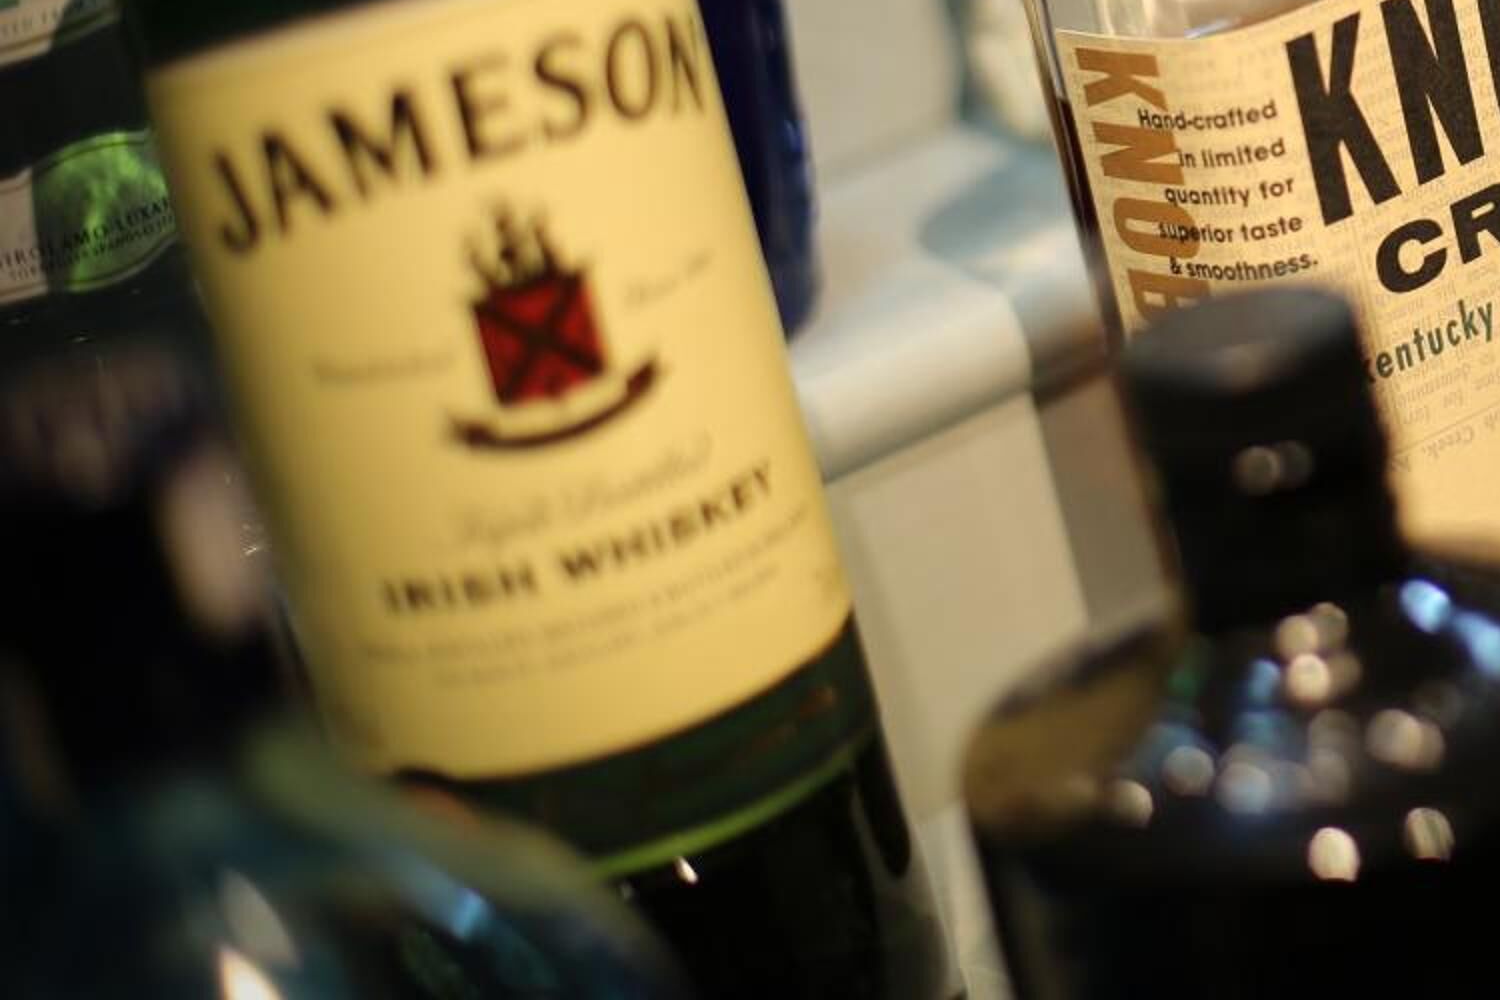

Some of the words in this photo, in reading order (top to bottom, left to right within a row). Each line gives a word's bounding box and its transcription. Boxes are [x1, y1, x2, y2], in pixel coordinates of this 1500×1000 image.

[1137, 100, 1279, 131] Hand-crafted
[214, 13, 709, 258] JAMESON
[1178, 148, 1197, 169] in
[1202, 138, 1286, 169] limited
[1164, 182, 1252, 208] quantity
[1259, 177, 1296, 200] for
[1159, 221, 1235, 244] superior
[1240, 216, 1304, 243] taste
[1169, 255, 1183, 276] &
[1186, 252, 1320, 282] smoothness.
